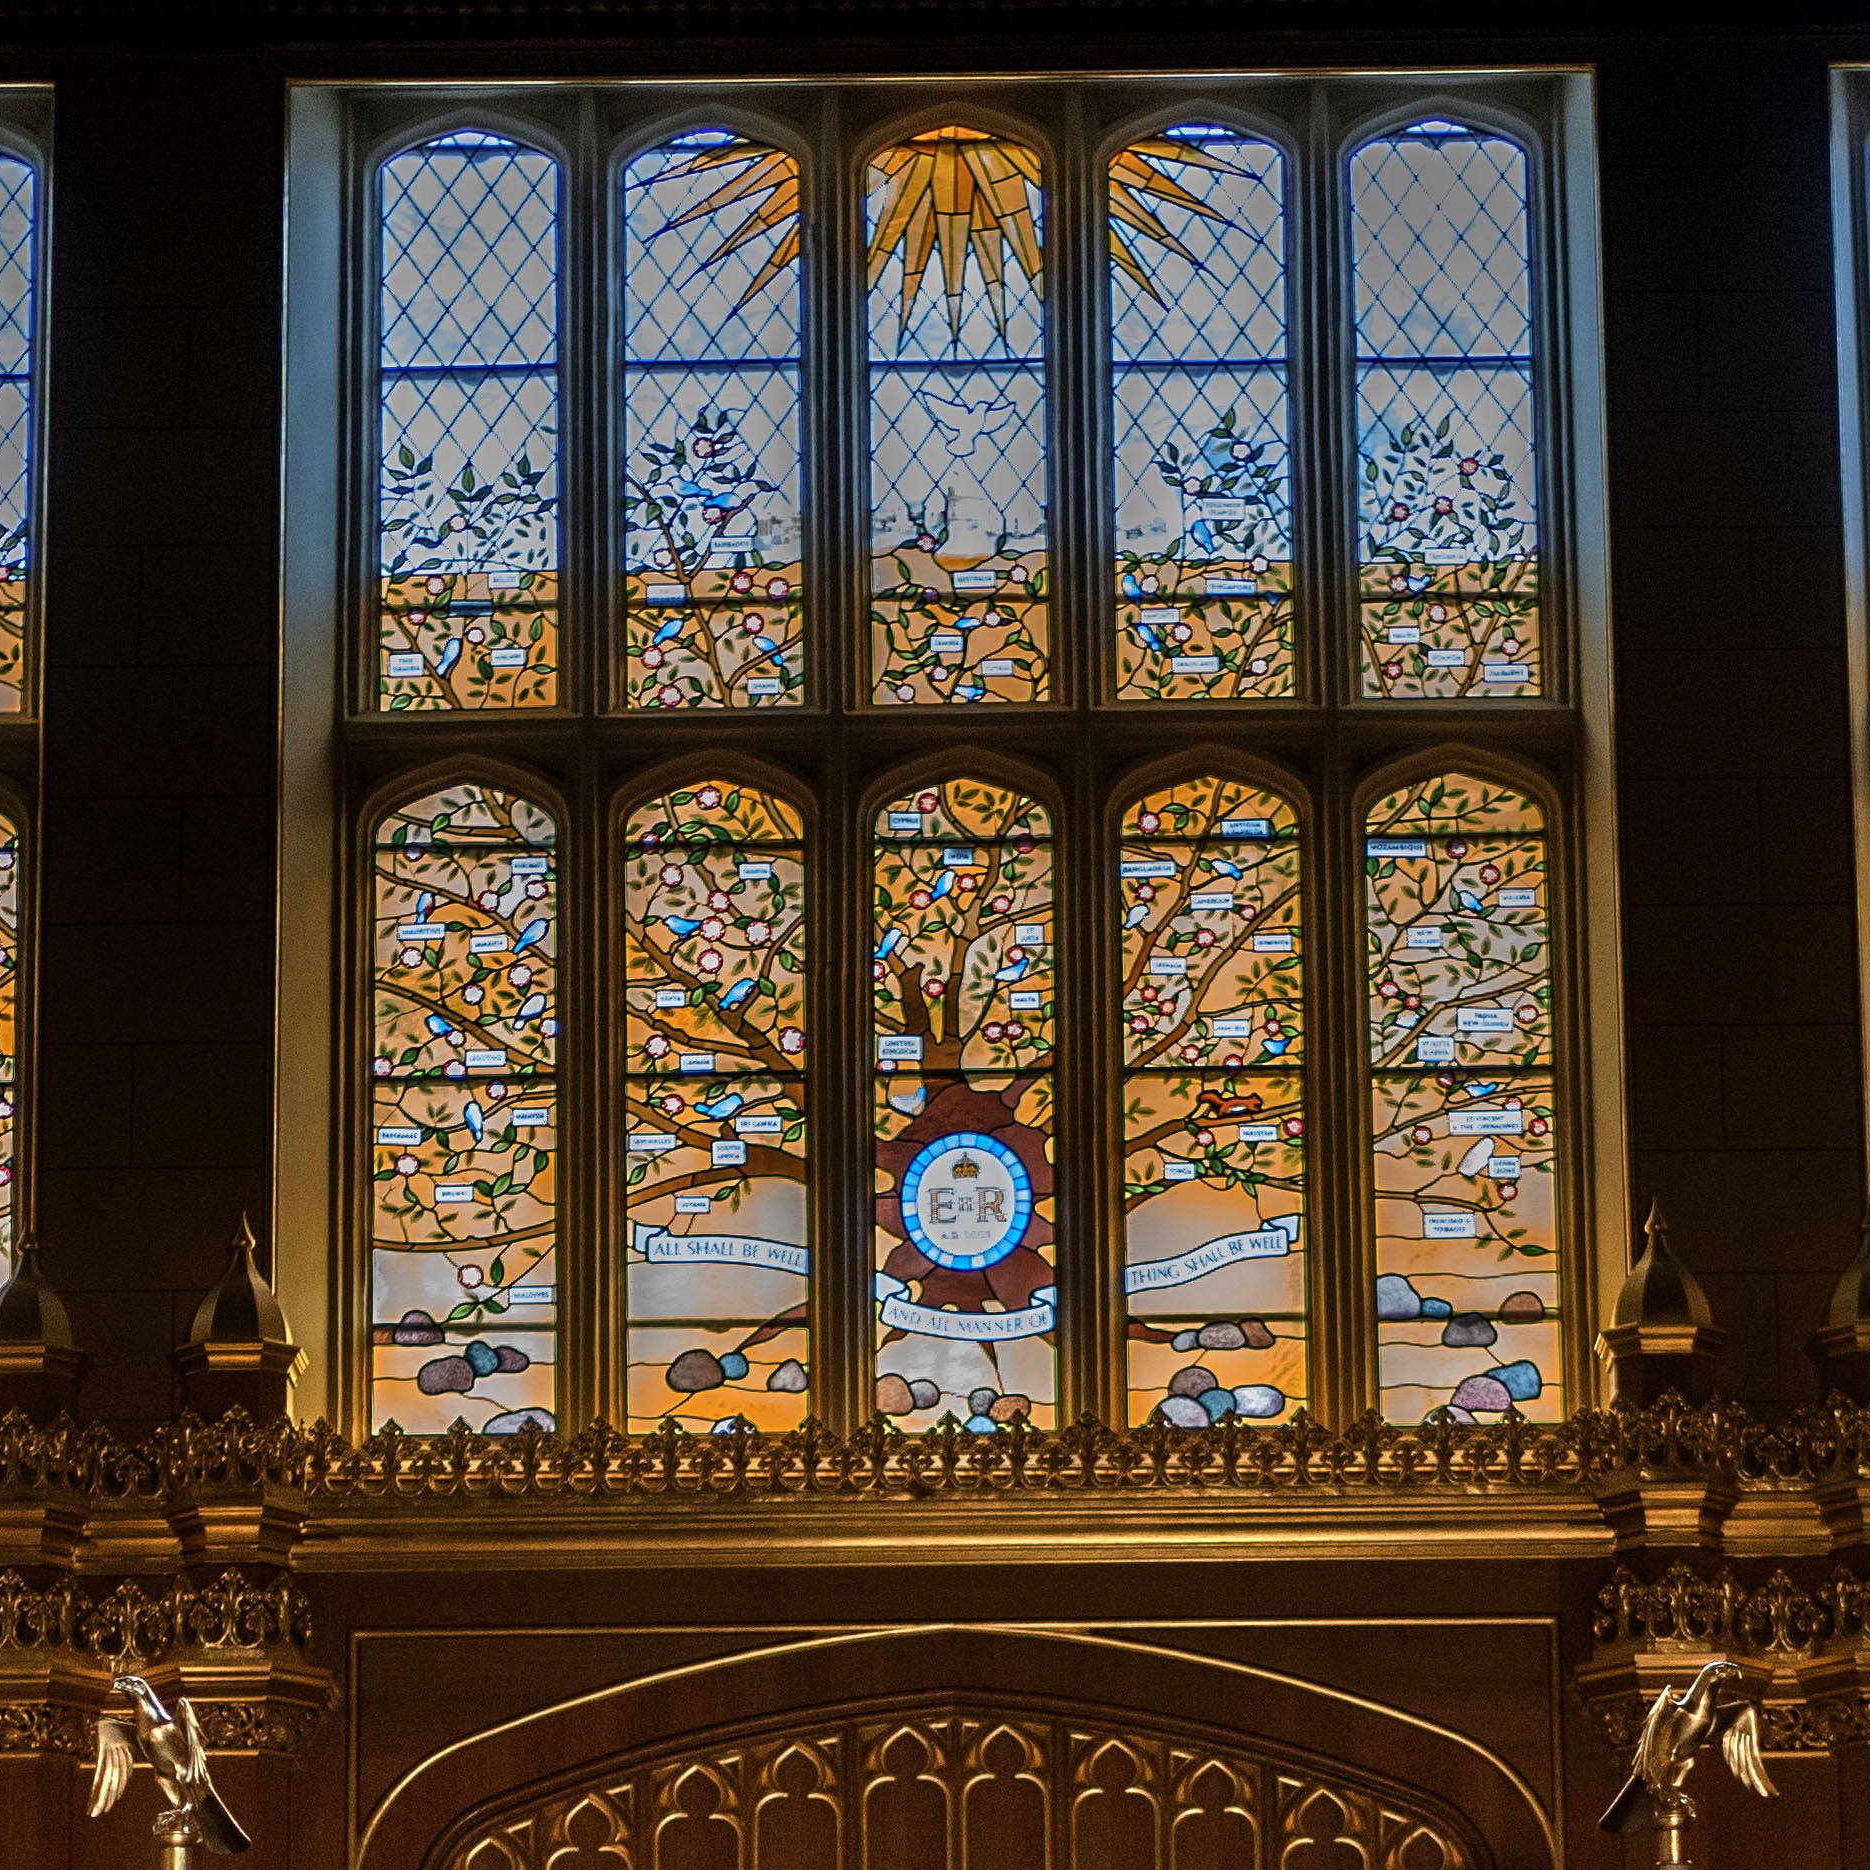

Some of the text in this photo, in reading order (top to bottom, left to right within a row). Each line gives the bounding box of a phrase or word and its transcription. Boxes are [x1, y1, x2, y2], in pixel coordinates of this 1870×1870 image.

[653, 1242, 803, 1267] ALL SHALL BE WELL
[1130, 1235, 1283, 1286] THING SHALL BE WELL
[888, 1306, 922, 1325] AND
[957, 1314, 1025, 1333] MANNER
[1028, 1311, 1048, 1328] OF
